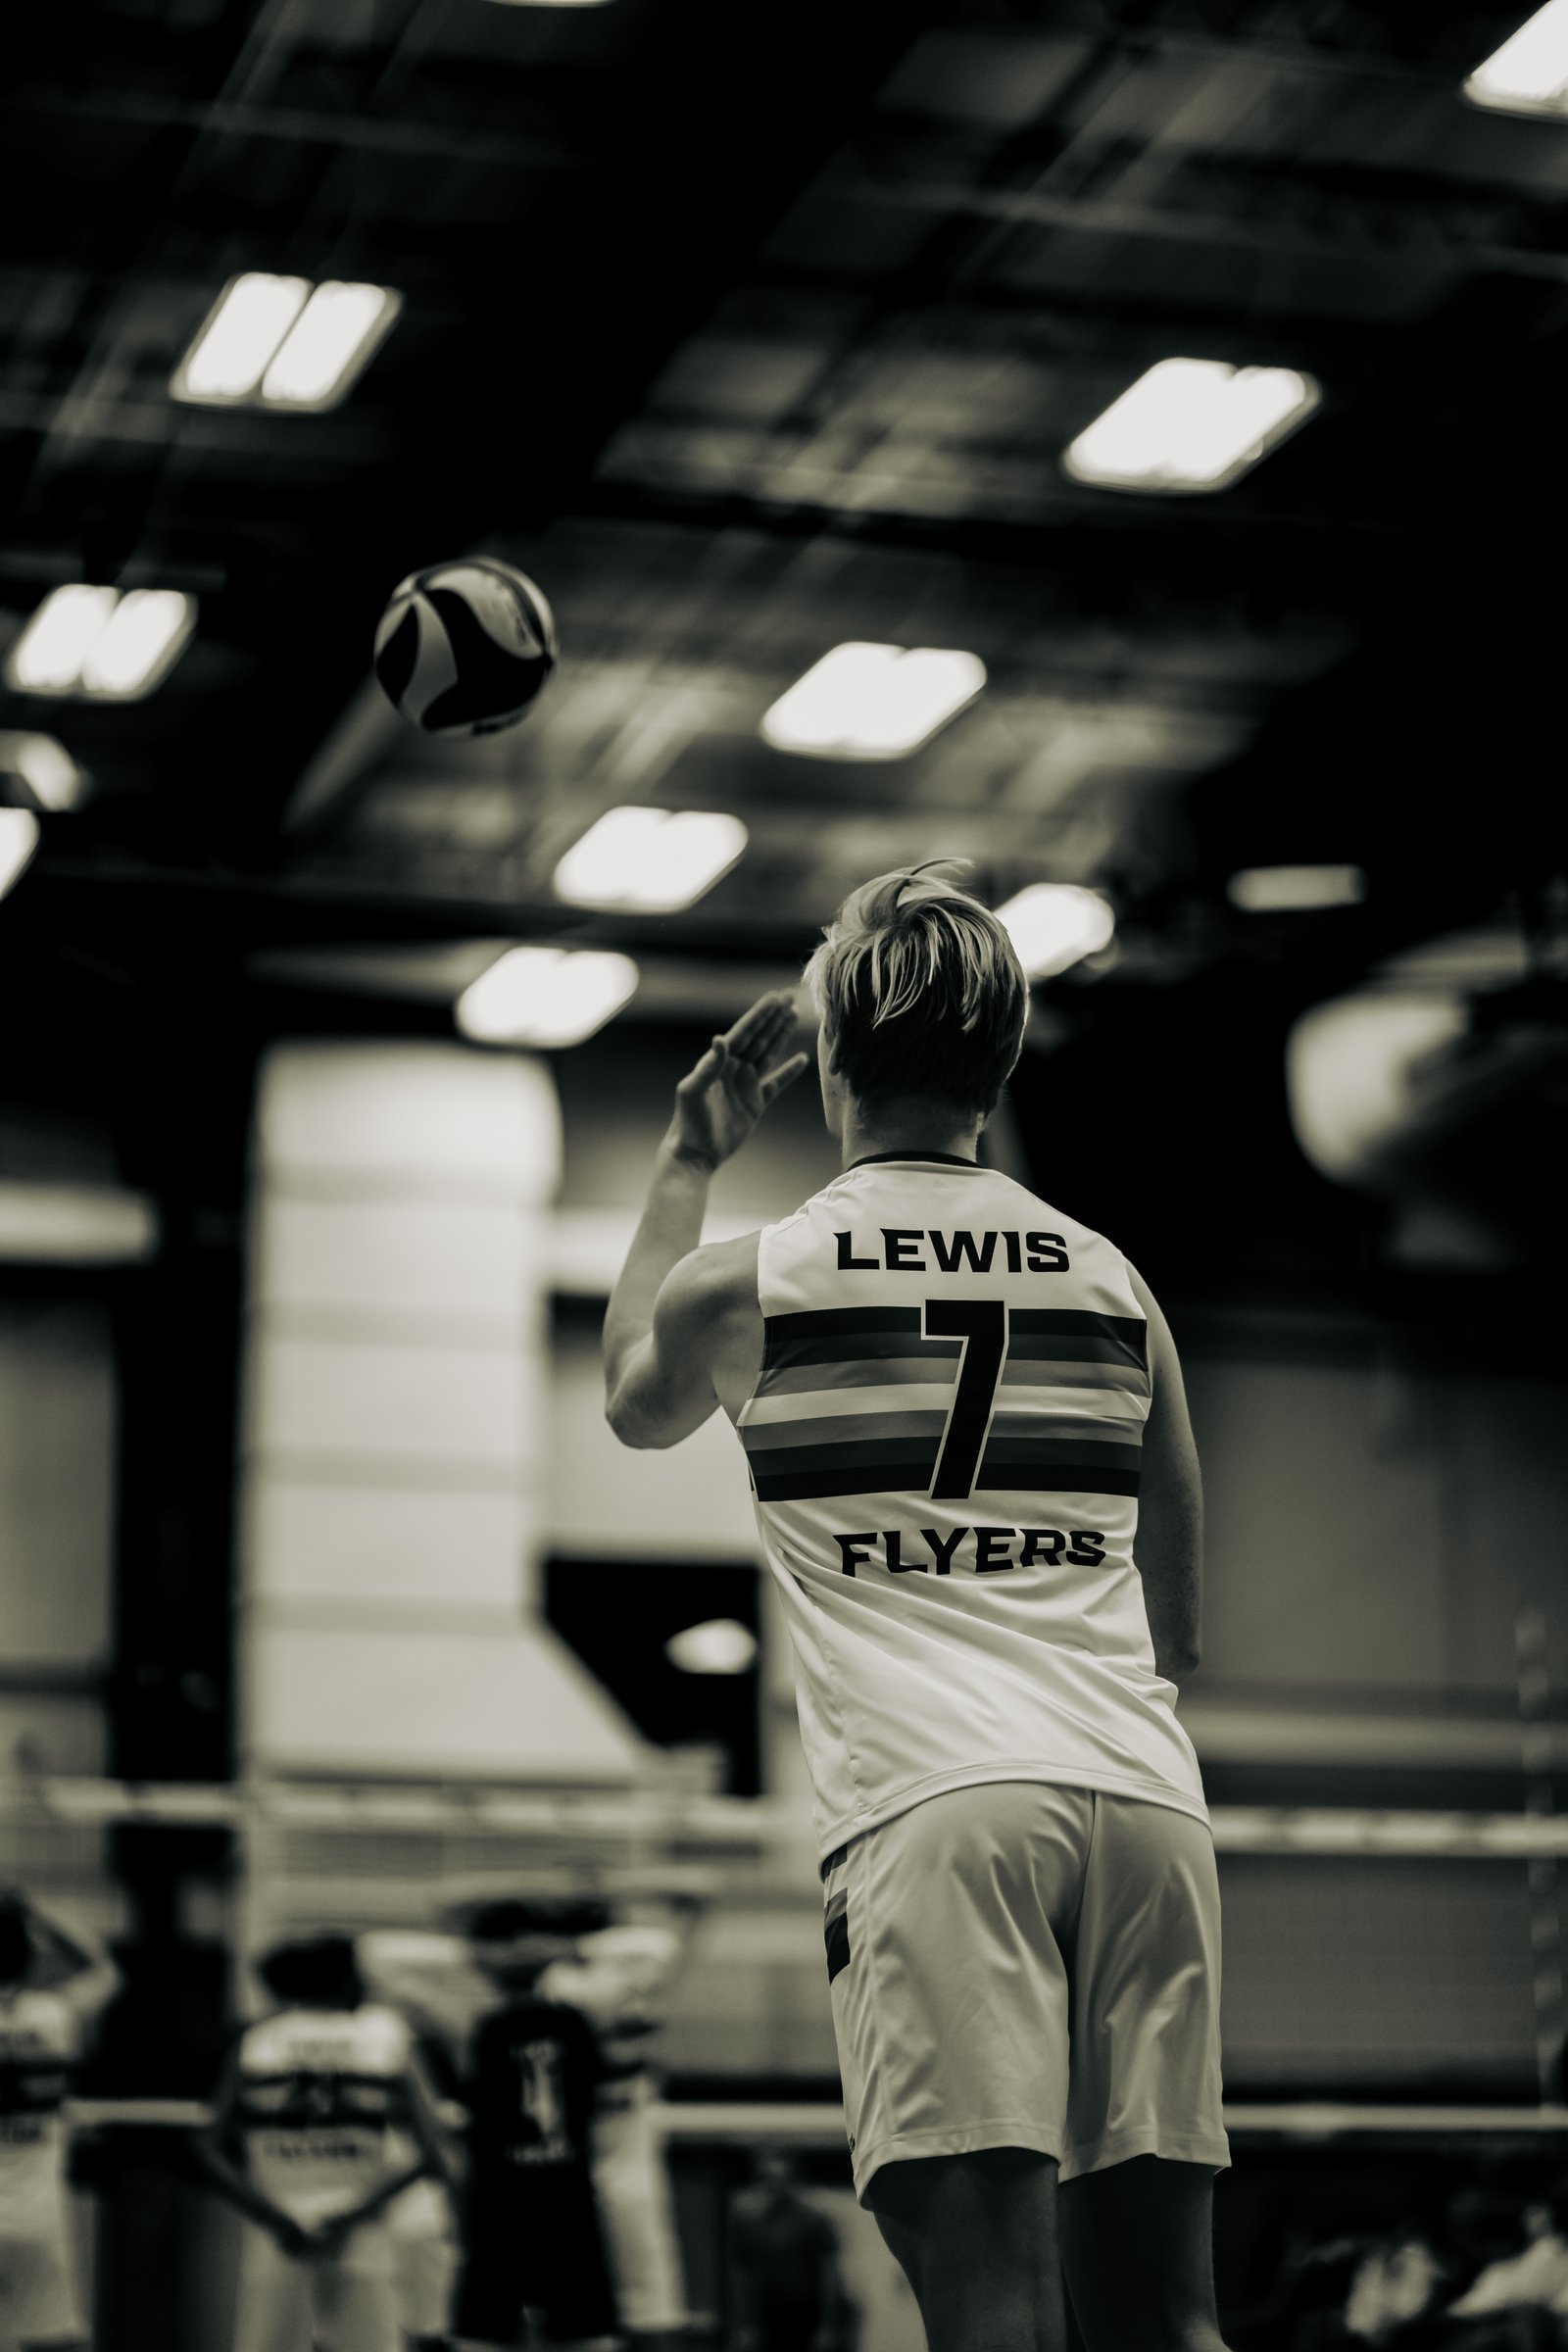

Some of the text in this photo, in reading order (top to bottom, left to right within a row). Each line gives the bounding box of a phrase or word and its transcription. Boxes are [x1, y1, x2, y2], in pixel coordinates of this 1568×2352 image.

[834, 1228, 1070, 1273] LEWIS
[922, 1298, 1009, 1499] 7
[833, 1527, 1106, 1577] FLYERS
